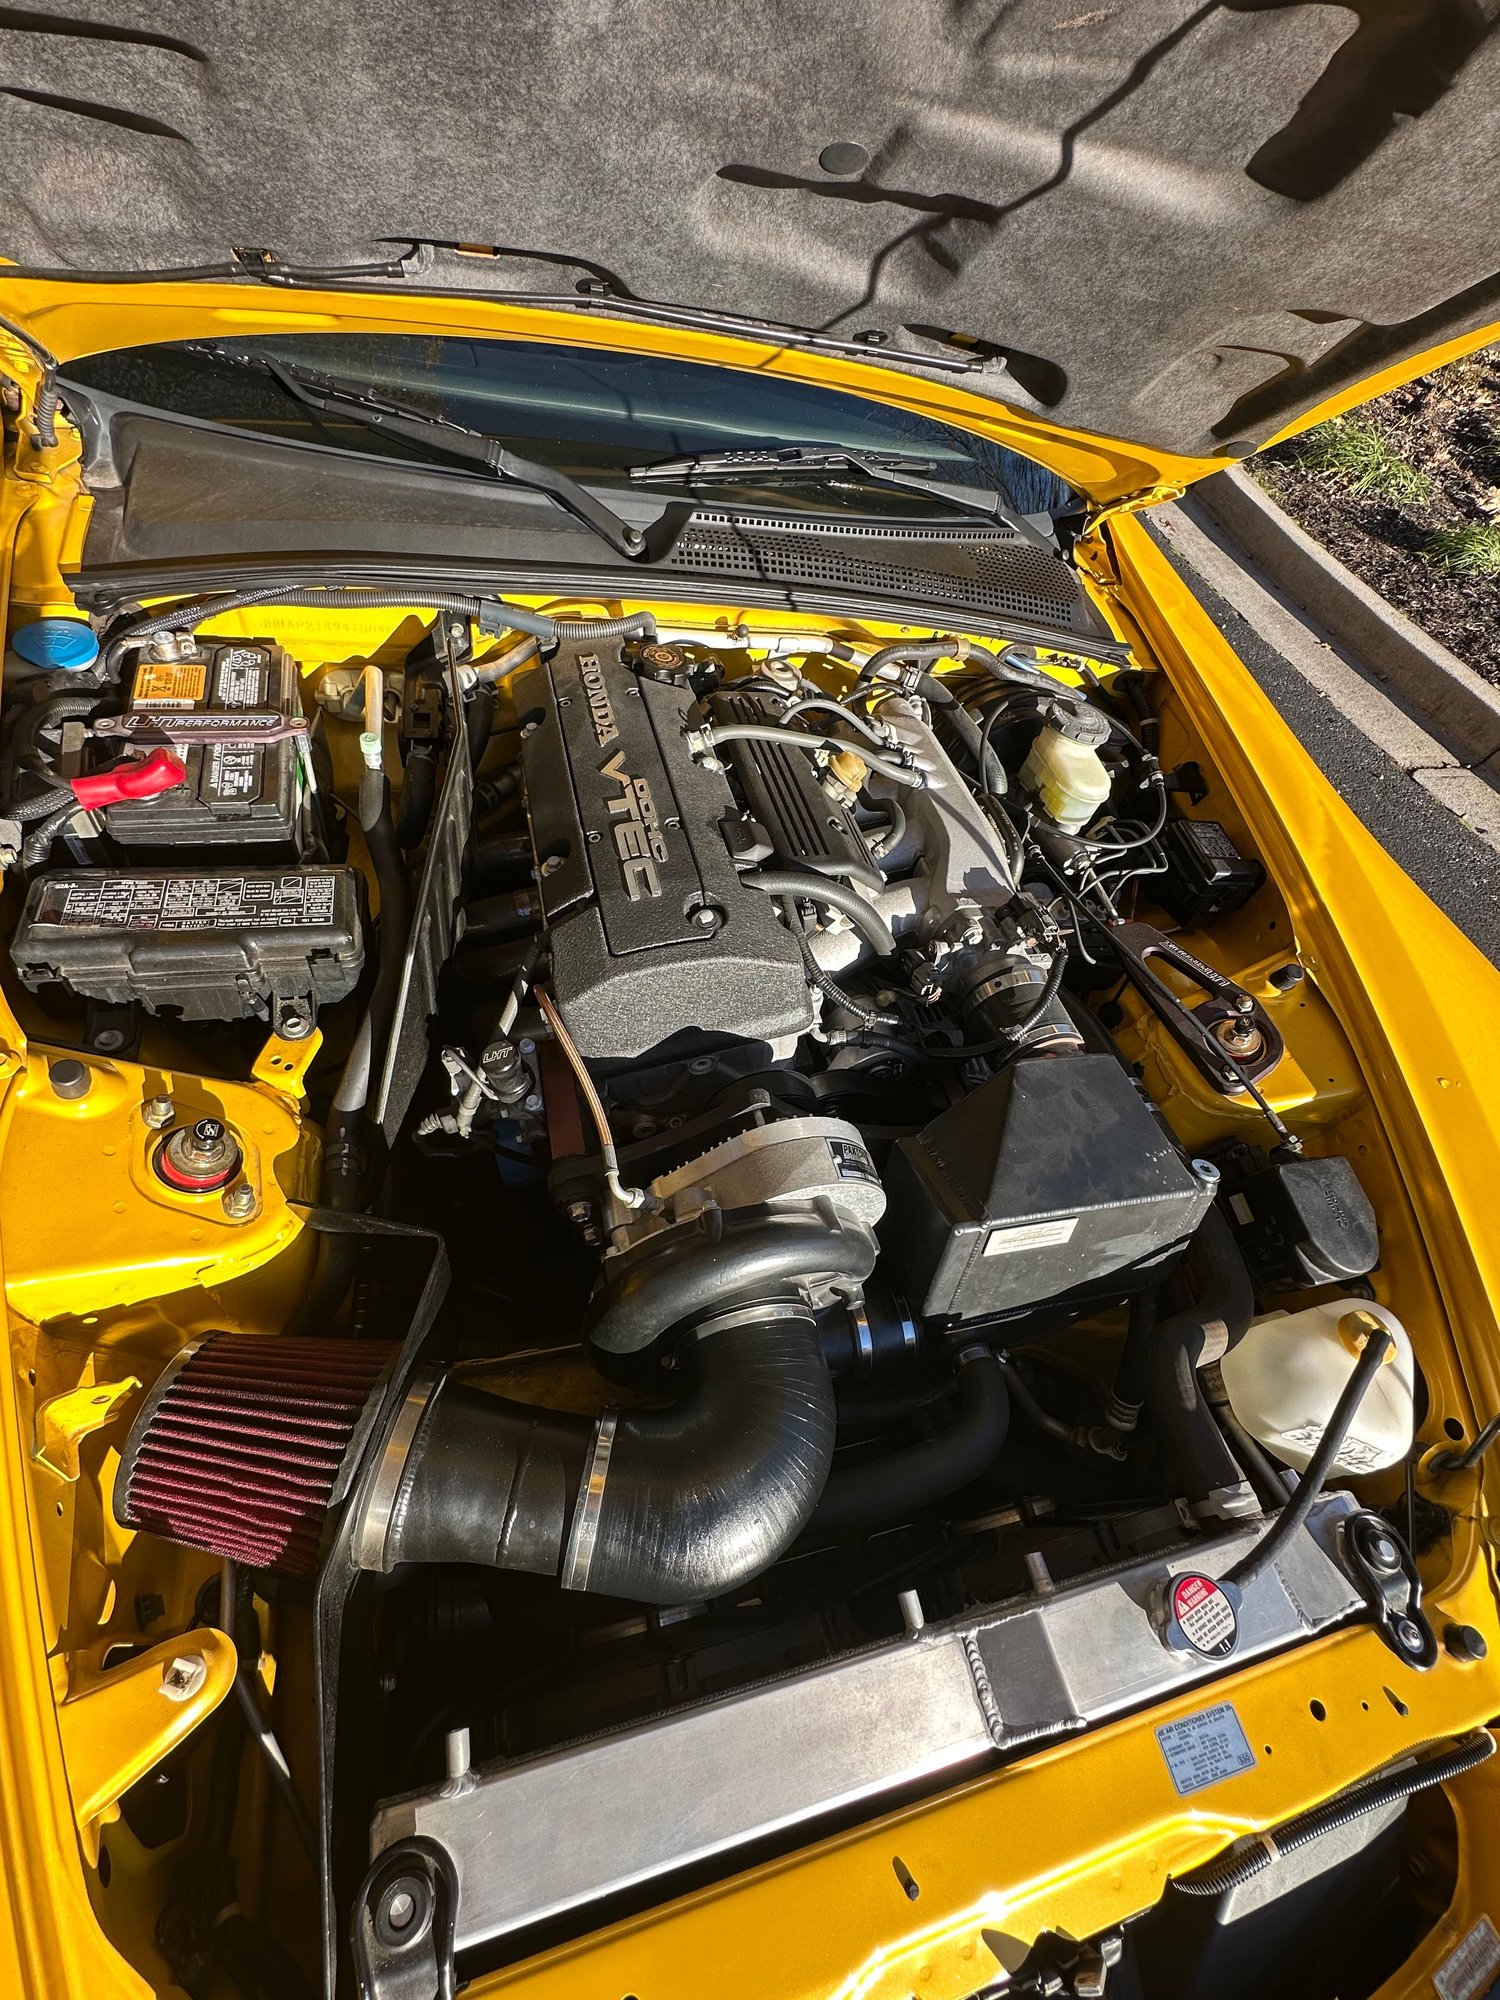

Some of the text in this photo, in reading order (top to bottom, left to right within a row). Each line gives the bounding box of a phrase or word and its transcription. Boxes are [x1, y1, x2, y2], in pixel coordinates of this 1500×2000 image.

[578, 653, 620, 747] HONDA
[600, 750, 663, 902] VTEC
[633, 777, 669, 863] DOHC
[482, 1046, 514, 1064] LHT
[1181, 1579, 1204, 1600] DANGER
[1186, 1587, 1209, 1608] WARNING
[1219, 1638, 1232, 1653] 1.1
[1174, 1714, 1206, 1731] CONDITIONER
[1205, 1706, 1228, 1720] SYSTEM
